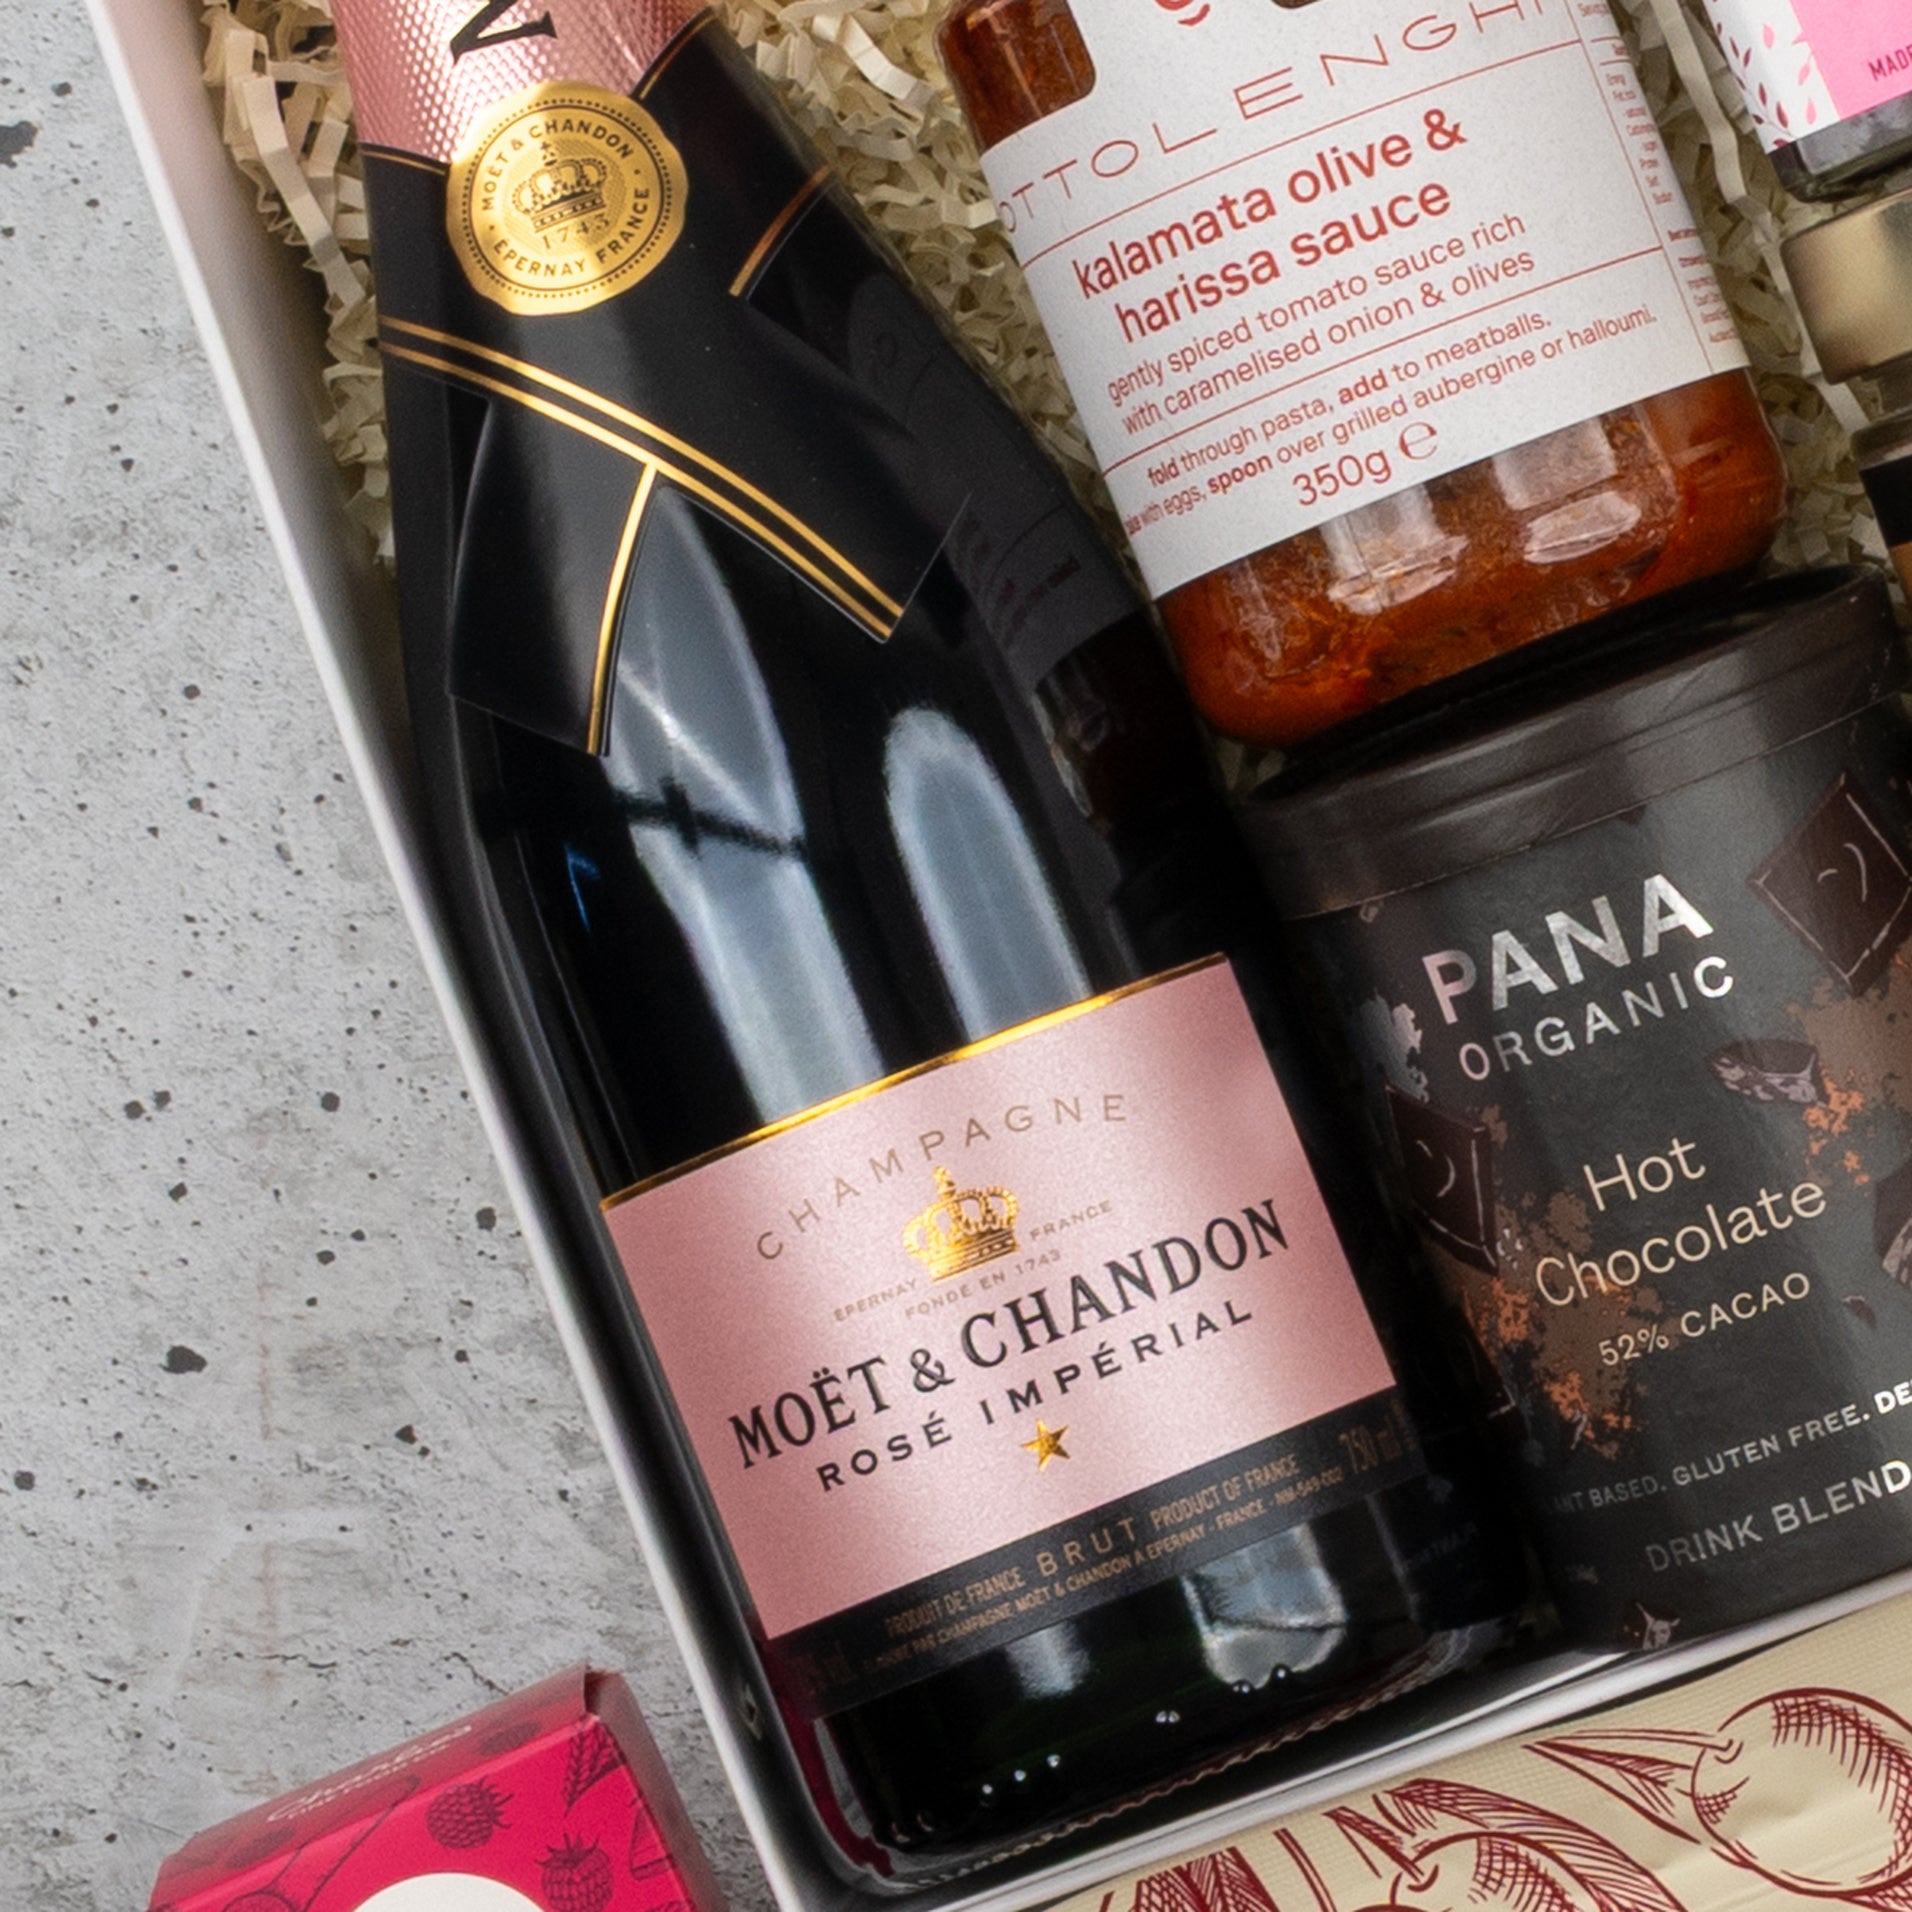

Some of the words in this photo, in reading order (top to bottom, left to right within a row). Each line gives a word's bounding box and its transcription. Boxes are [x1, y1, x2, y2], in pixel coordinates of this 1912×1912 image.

[529, 118, 634, 160] CHANDON
[596, 187, 650, 265] FRANCE
[1072, 187, 1277, 299] kalamata
[1288, 133, 1412, 202] olive
[1423, 108, 1467, 151] &
[1115, 250, 1281, 343] harissa
[1290, 183, 1451, 266] sauce
[1108, 359, 1163, 406] gently
[1167, 317, 1253, 373] spiced
[1255, 275, 1368, 332] tomato
[1375, 237, 1465, 286] sauce
[1472, 213, 1526, 250] rich
[1122, 402, 1162, 435] with
[1164, 328, 1321, 415] caramelised
[1327, 297, 1414, 344] onion
[1421, 282, 1445, 308] &
[1452, 250, 1535, 297] olives
[1148, 457, 1180, 488] fold
[1180, 426, 1257, 472] through
[1262, 398, 1335, 442] pasta,
[1338, 369, 1389, 405] add
[1392, 362, 1421, 384] to
[1425, 312, 1552, 370] meatballs.
[1207, 454, 1273, 494] spoon
[1277, 430, 1325, 464] over
[1333, 390, 1408, 444] grilled
[1414, 346, 1536, 407] aubergine
[1542, 337, 1564, 359] or
[1569, 305, 1657, 345] halloumi.
[1293, 450, 1392, 506] 350g
[1421, 873, 1715, 1025] PANA
[1458, 955, 1734, 1081] ORGANIC
[757, 1094, 1127, 1260] CHAMPAGNE
[1030, 1201, 1113, 1241] FRANCE
[1583, 1137, 1706, 1211] Hot
[979, 1272, 1006, 1290] EN
[1016, 1249, 1062, 1275] 1743
[1535, 1181, 1827, 1306] Chocolate
[728, 1357, 890, 1469] MOËT
[909, 1348, 956, 1394] &
[961, 1199, 1289, 1368] CHANDON
[1599, 1323, 1670, 1366] 52%
[1680, 1272, 1811, 1338] CACAO
[816, 1410, 952, 1492] ROSÉ
[979, 1300, 1253, 1424] IMPÉRIAL
[1589, 1475, 1667, 1508] BASED.
[1672, 1435, 1781, 1487] GLUTEN
[1788, 1403, 1870, 1447] FREE.
[1874, 1380, 1912, 1414] DE
[944, 1592, 967, 1614] DE
[966, 1566, 1026, 1607] FRANCE
[1037, 1517, 1136, 1577] BRUT
[1150, 1485, 1222, 1531] PRODUCT
[1223, 1475, 1242, 1500] OF
[1244, 1453, 1299, 1492] FRANCE
[1065, 1553, 1134, 1592] CHANDON
[1645, 1515, 1763, 1573] DRINK
[1771, 1460, 1911, 1535] BLEND
